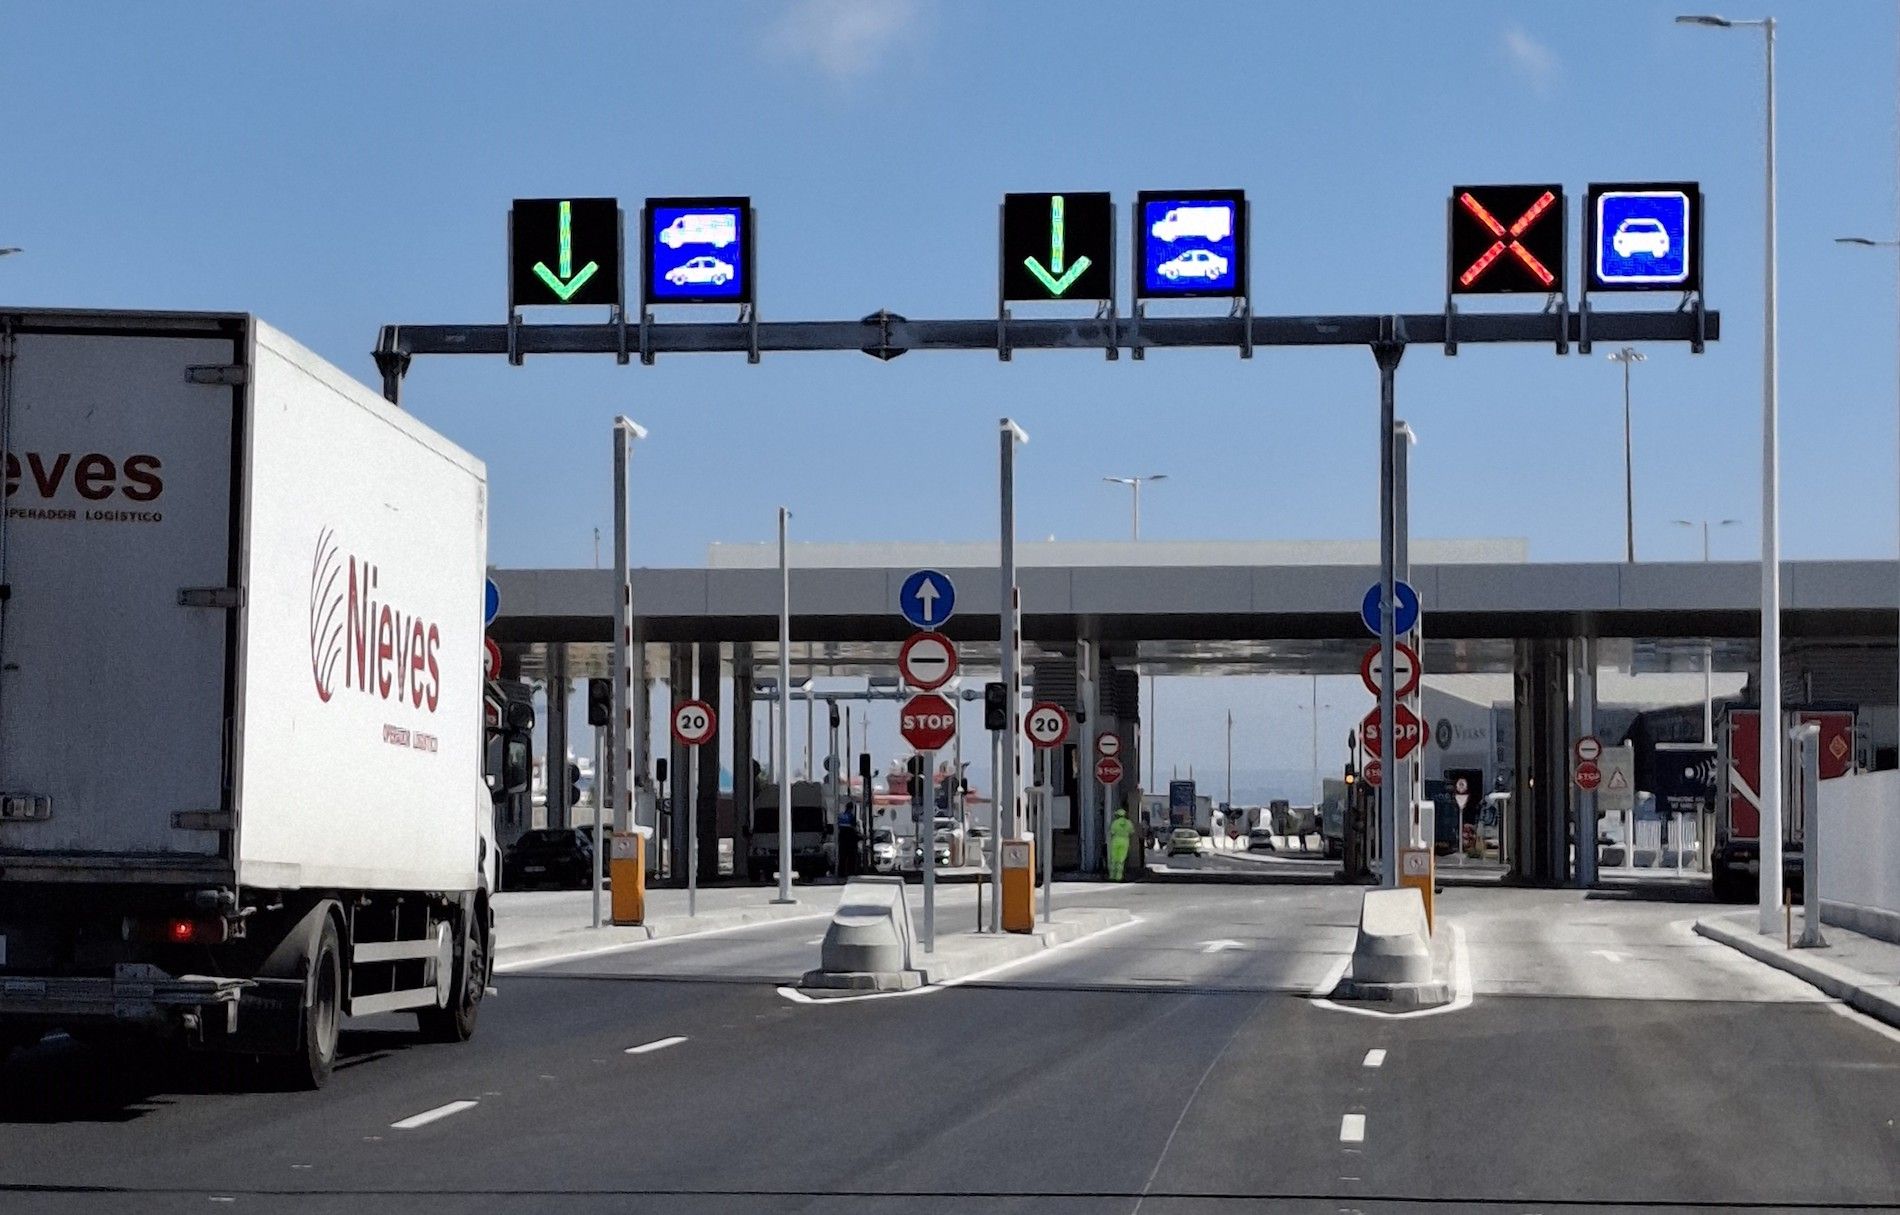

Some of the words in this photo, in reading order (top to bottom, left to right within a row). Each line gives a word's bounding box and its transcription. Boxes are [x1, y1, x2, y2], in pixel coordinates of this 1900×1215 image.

[346, 554, 440, 713] Nieves
[681, 715, 705, 729] 20
[903, 714, 954, 730] STOP
[1034, 718, 1059, 732] 20
[1366, 724, 1418, 740] SOP
